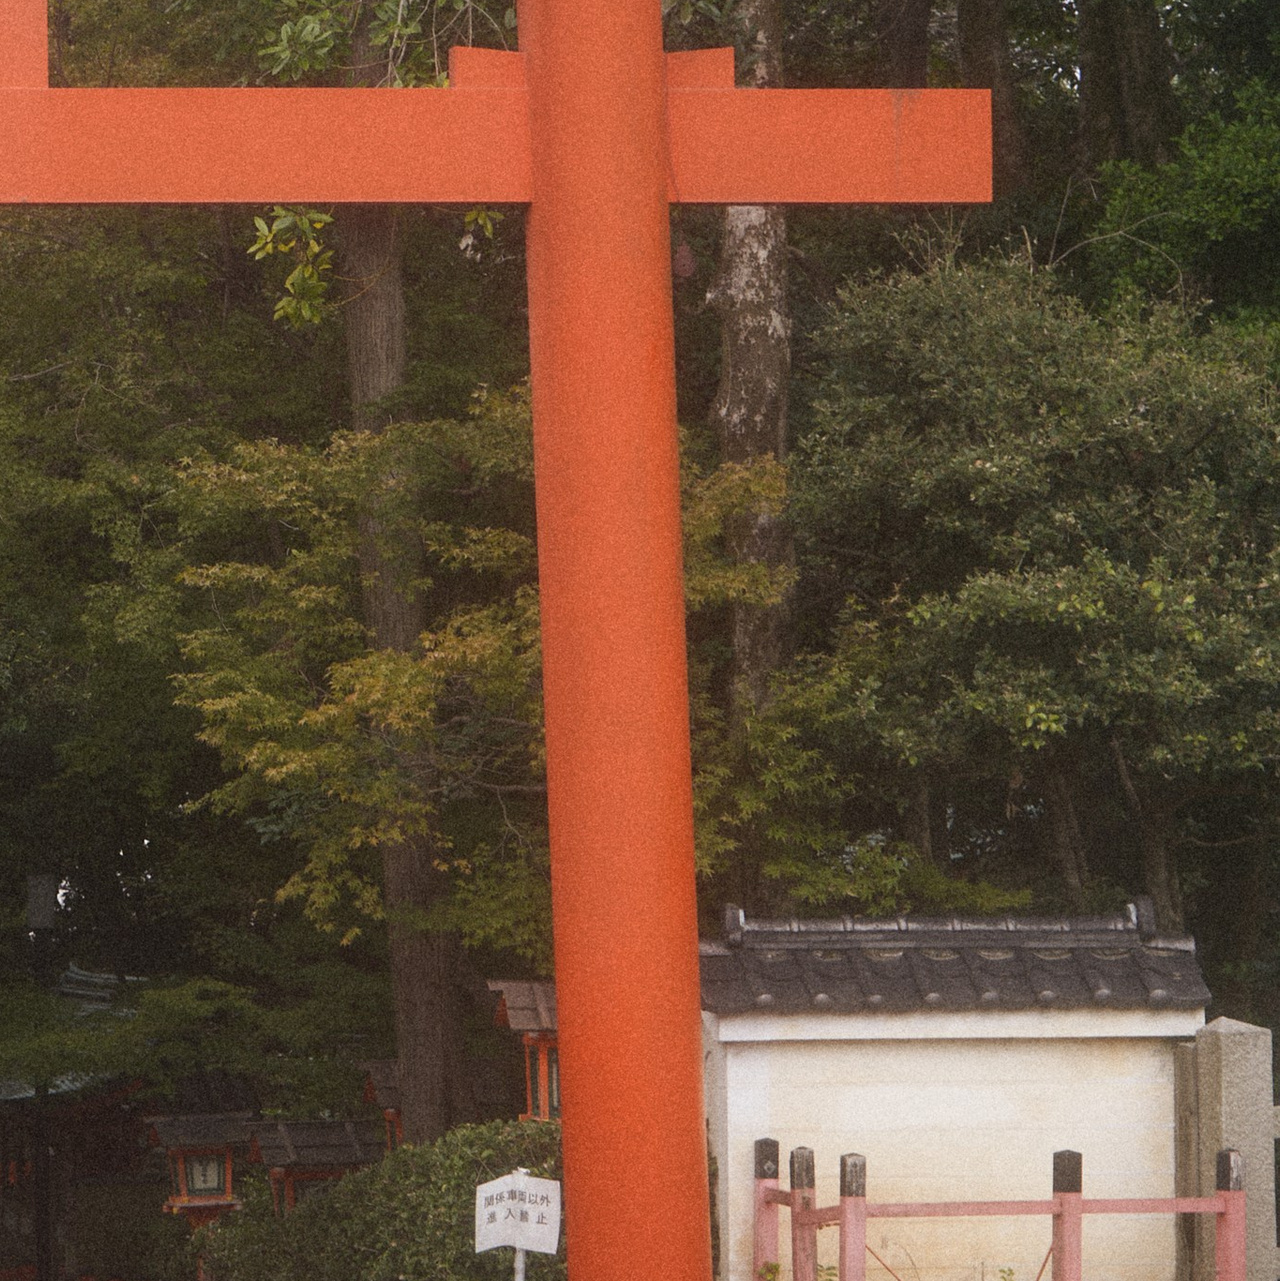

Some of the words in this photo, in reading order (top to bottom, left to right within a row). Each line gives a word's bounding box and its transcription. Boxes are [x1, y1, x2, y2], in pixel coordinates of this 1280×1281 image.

[484, 1189, 551, 1208] 関係車両以外
